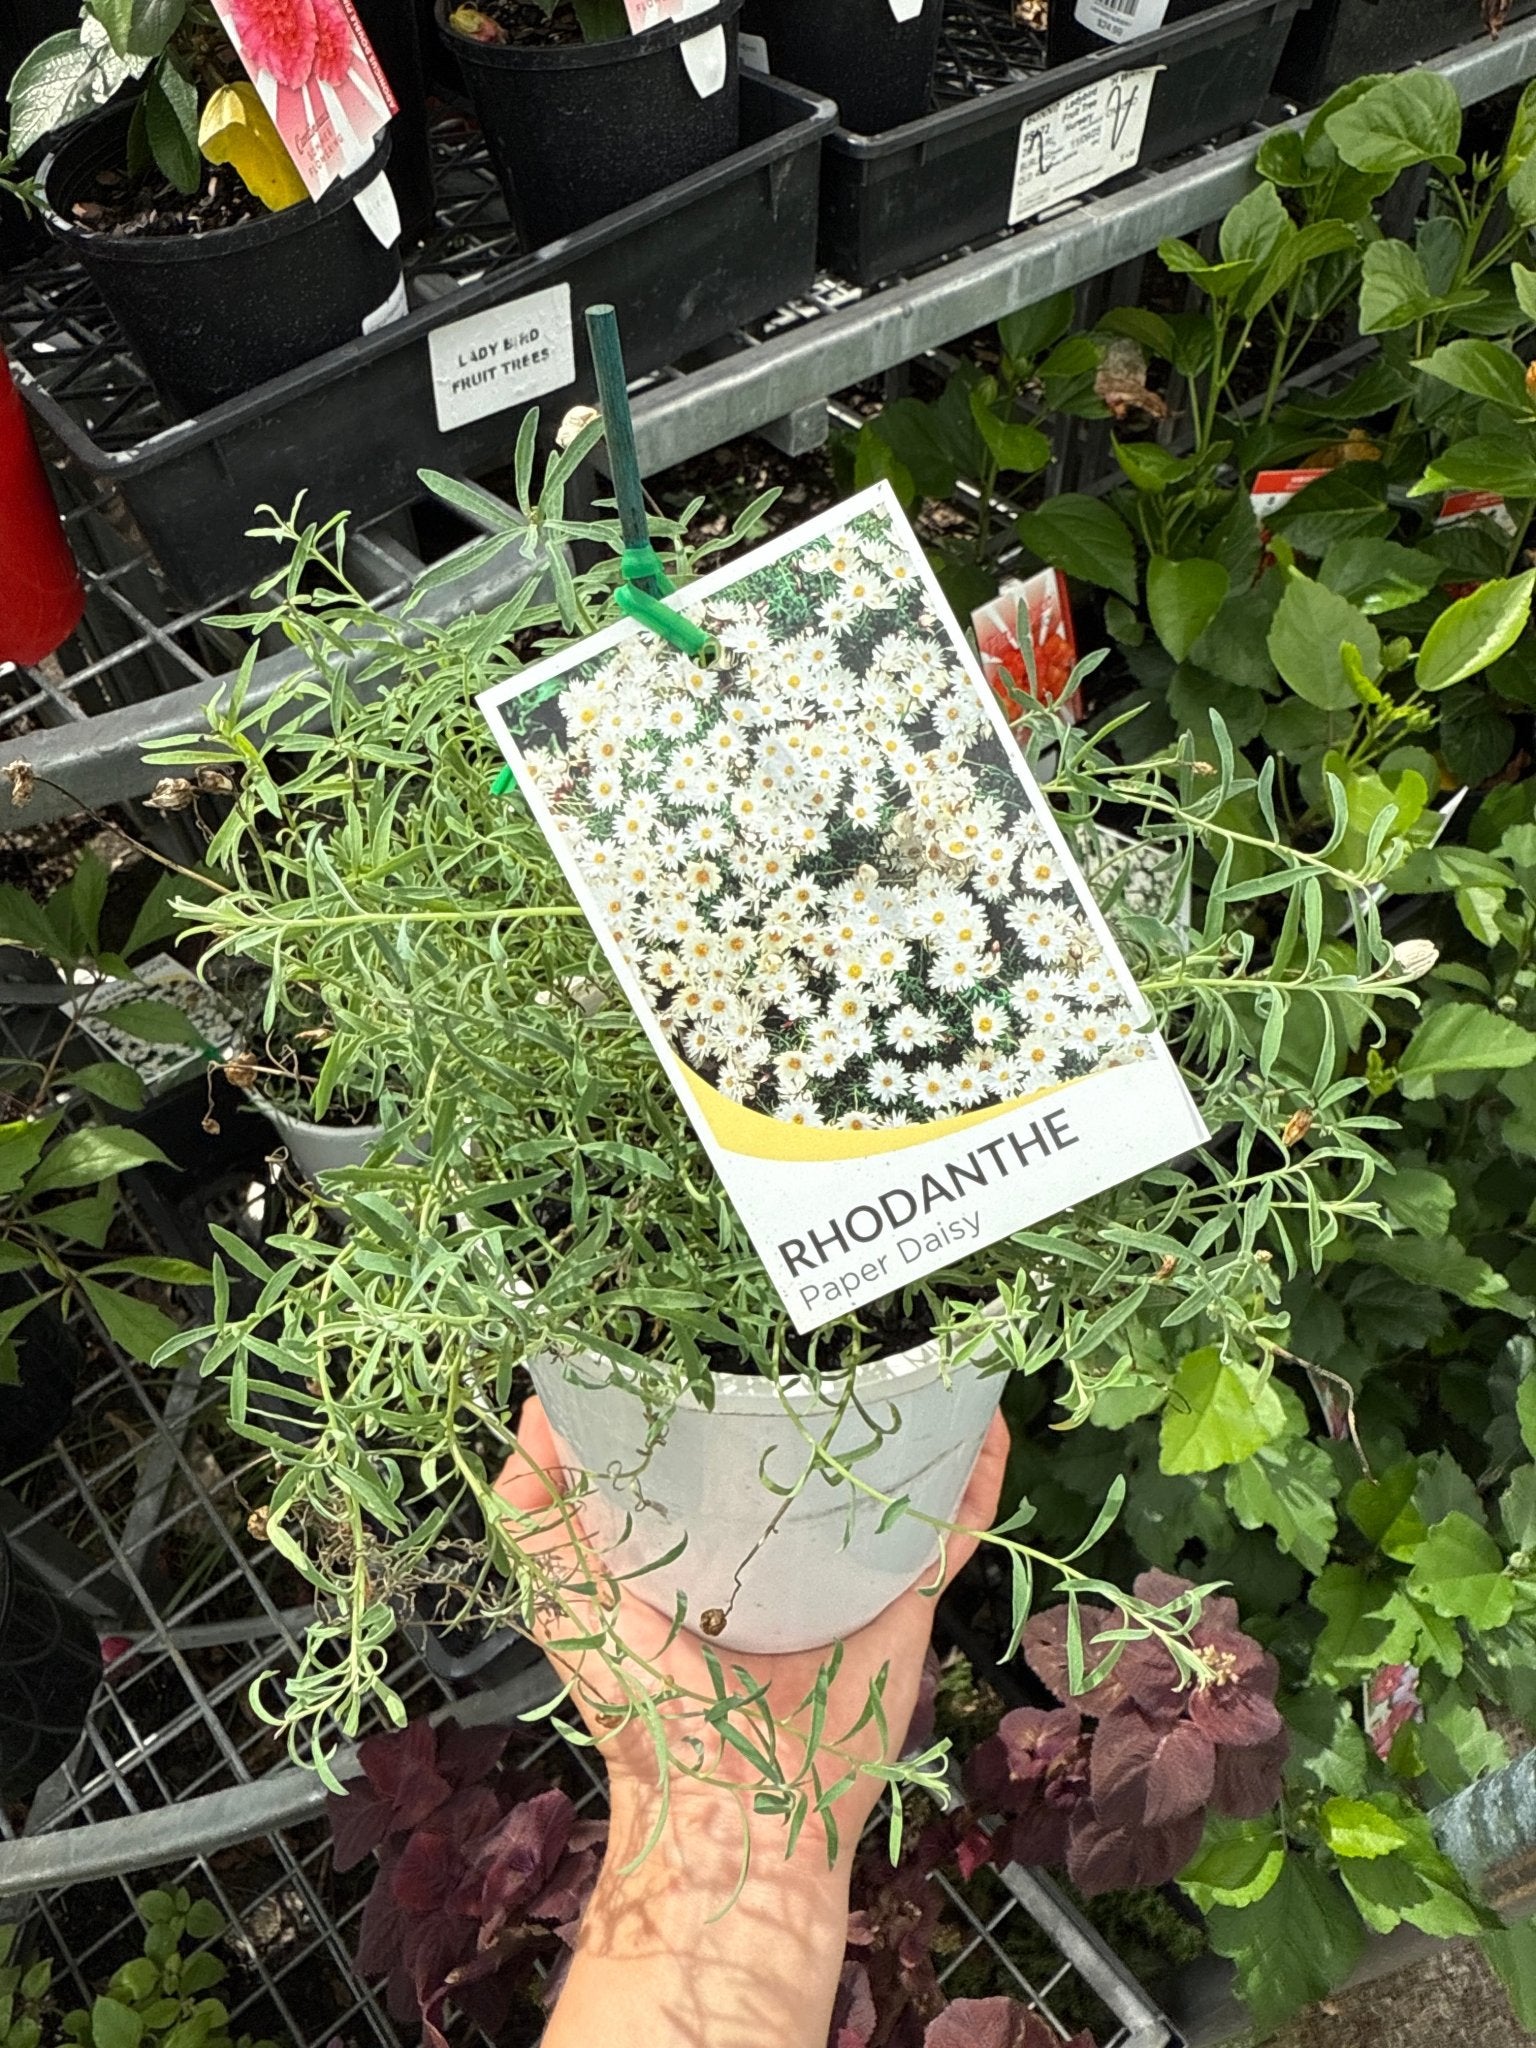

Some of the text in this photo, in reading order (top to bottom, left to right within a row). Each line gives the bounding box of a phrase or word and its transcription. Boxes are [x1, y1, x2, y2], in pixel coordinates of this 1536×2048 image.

[452, 348, 549, 394] FRUIT TREES
[458, 342, 498, 368] LADY
[777, 1107, 1080, 1278] RHODANTHE
[798, 1211, 981, 1311] Paper Daisy
